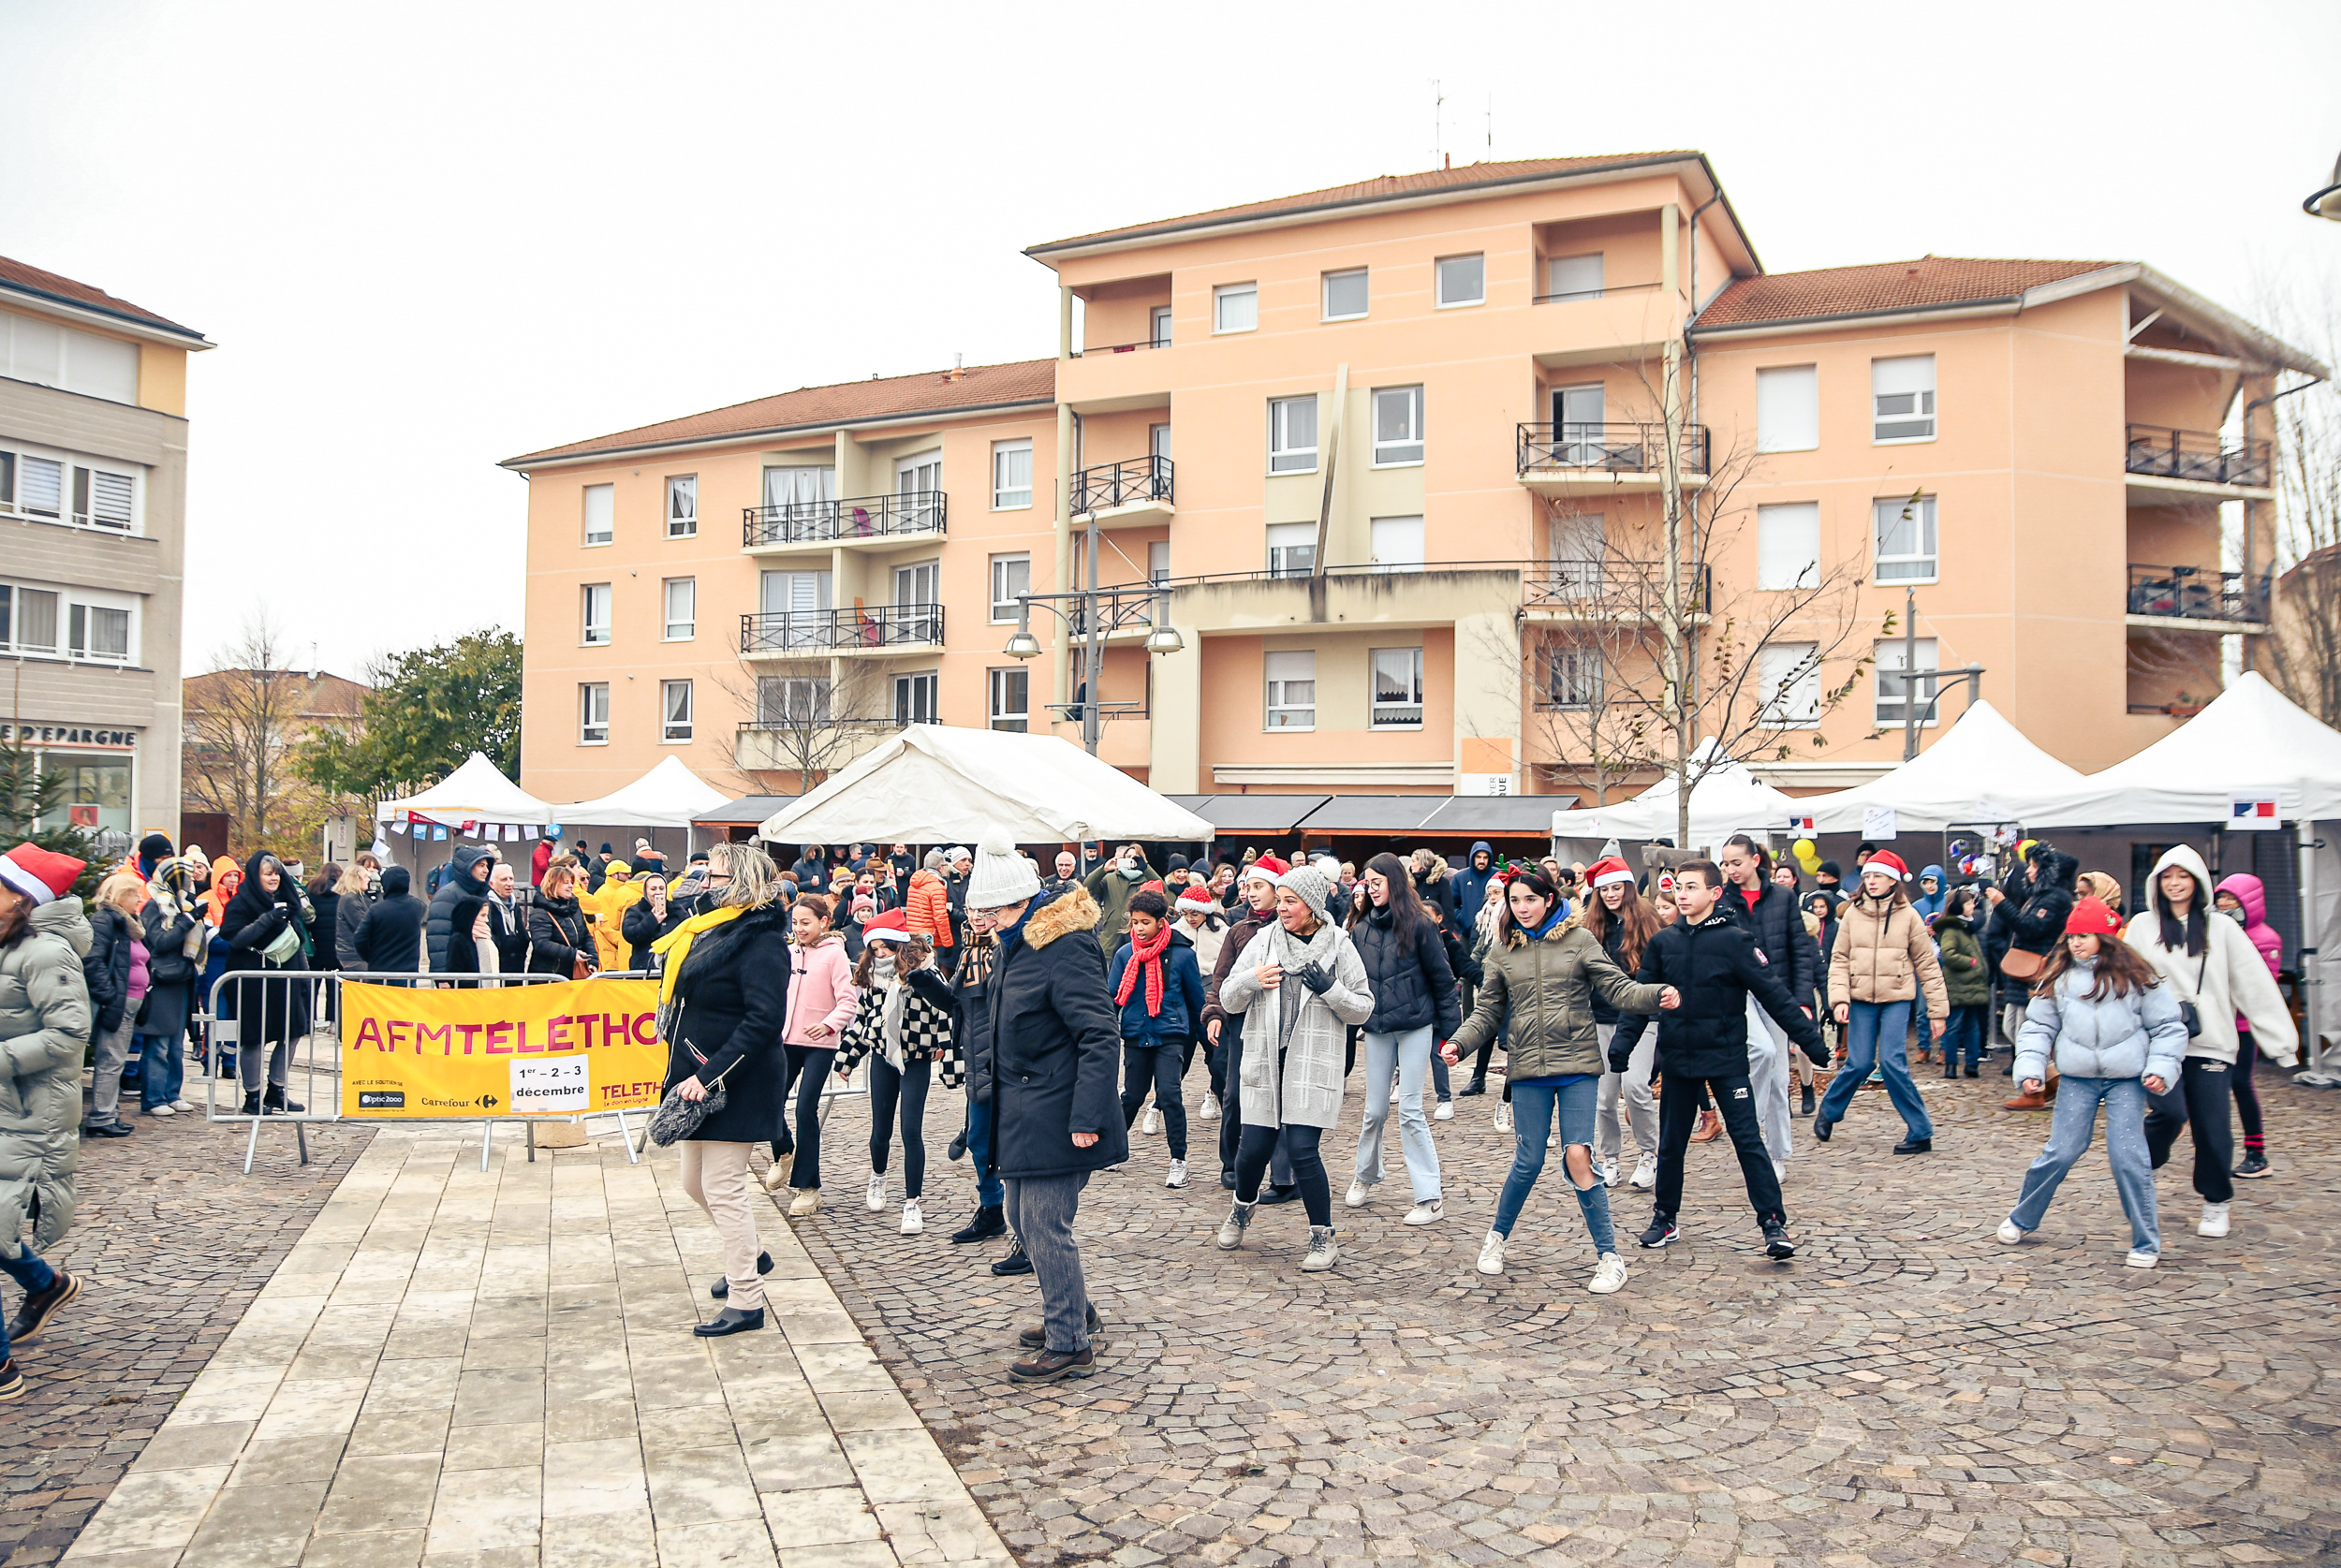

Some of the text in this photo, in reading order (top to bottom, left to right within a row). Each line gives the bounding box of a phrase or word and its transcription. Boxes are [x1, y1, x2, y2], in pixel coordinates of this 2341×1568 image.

[19, 725, 137, 746] D'EPARGNE
[551, 1067, 559, 1077] 2
[574, 1065, 582, 1076] 3
[516, 1085, 584, 1097] décembre
[421, 1097, 470, 1107] Carrefour
